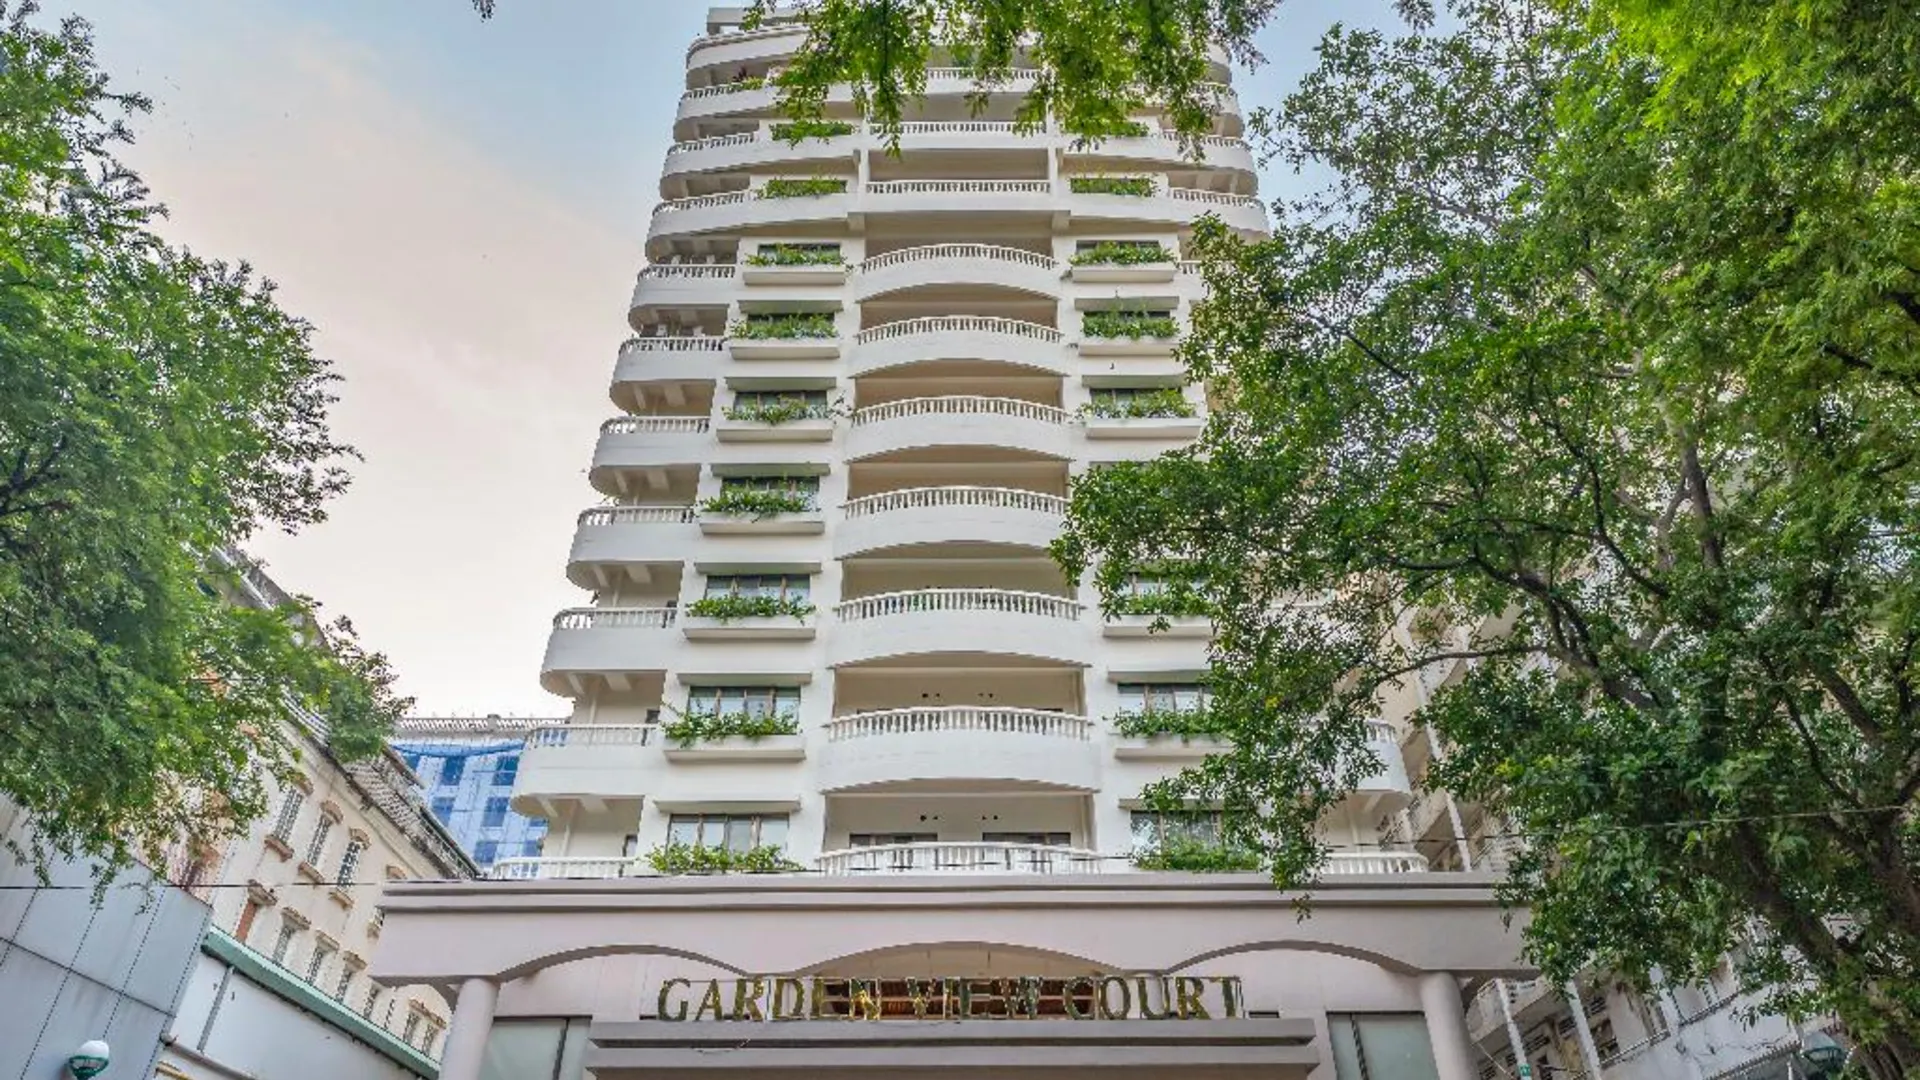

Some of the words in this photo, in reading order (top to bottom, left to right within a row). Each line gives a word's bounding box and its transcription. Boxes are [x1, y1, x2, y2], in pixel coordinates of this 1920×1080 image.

[658, 977, 880, 1020] GARDEN
[906, 976, 1043, 1020] VIEW
[1063, 976, 1241, 1020] COURT
